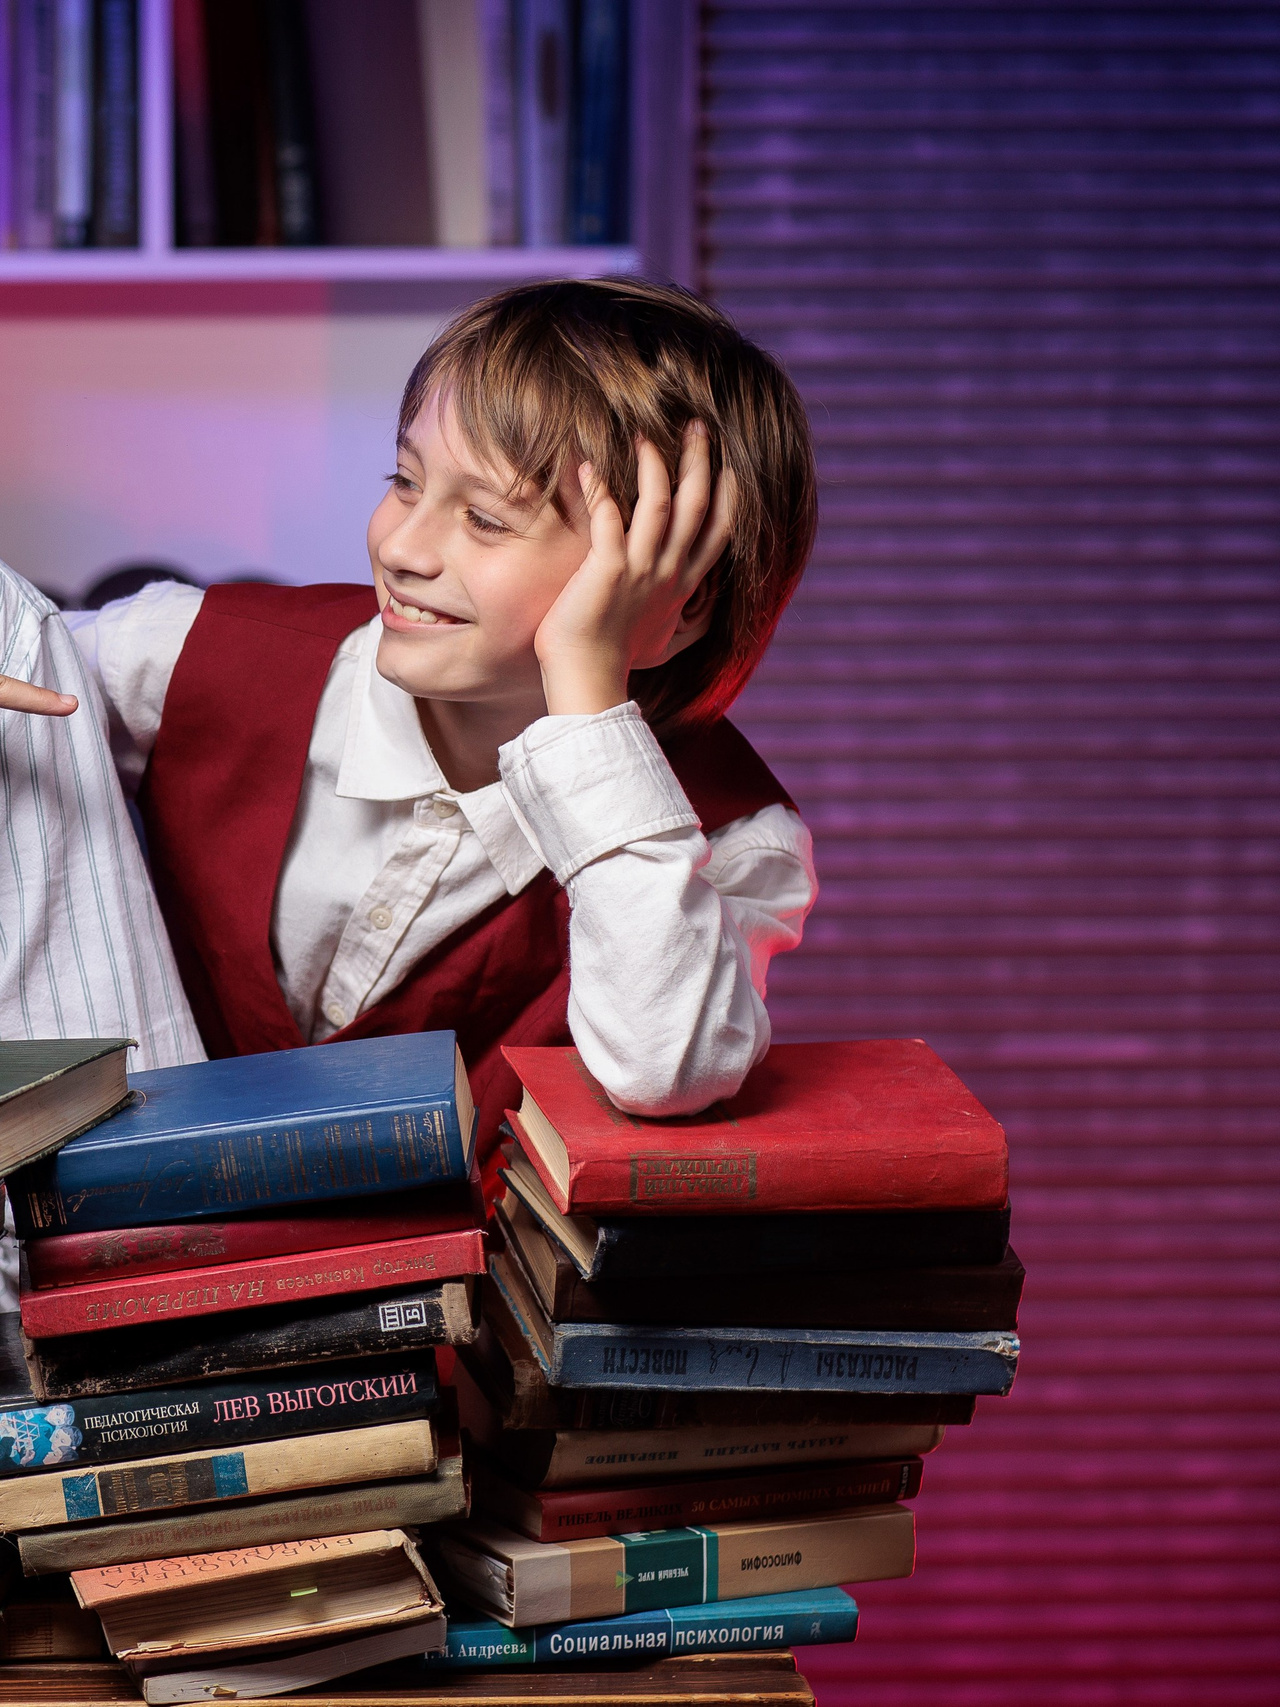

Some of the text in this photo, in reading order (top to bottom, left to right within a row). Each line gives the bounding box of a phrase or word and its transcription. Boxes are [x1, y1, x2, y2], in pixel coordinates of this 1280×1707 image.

[86, 1254, 437, 1321] Виктор Казначеев НА ПЕРЕЛОМЕ
[603, 1347, 687, 1374] ПОВЕСТИ
[817, 1351, 918, 1380] РАССКАЗЫ
[213, 1369, 419, 1423] ЛЕВ ВЫГОТСКИЙ
[84, 1401, 200, 1431] ПЕДАГОГИЧЕСКАЯ
[101, 1420, 189, 1444] ПСИХОЛОГИЯ
[788, 1434, 849, 1450] ЛАЗАРЬ
[584, 1450, 679, 1465] ИЗБРАННОЕ
[558, 1511, 612, 1528] ГИБЕЛЬ
[616, 1505, 683, 1522] ВЕЛИКИХ
[690, 1500, 706, 1514] 50
[708, 1496, 760, 1511] САМЫХ
[103, 1537, 354, 1589] БИБЛИОТЕКА
[637, 1566, 689, 1583] УЧЕБНЫЙ КУРС
[741, 1550, 802, 1571] ФИЛОСОФИЯ
[457, 1643, 528, 1660] Андреева
[549, 1629, 667, 1656] Социальная
[674, 1624, 784, 1648] психология
